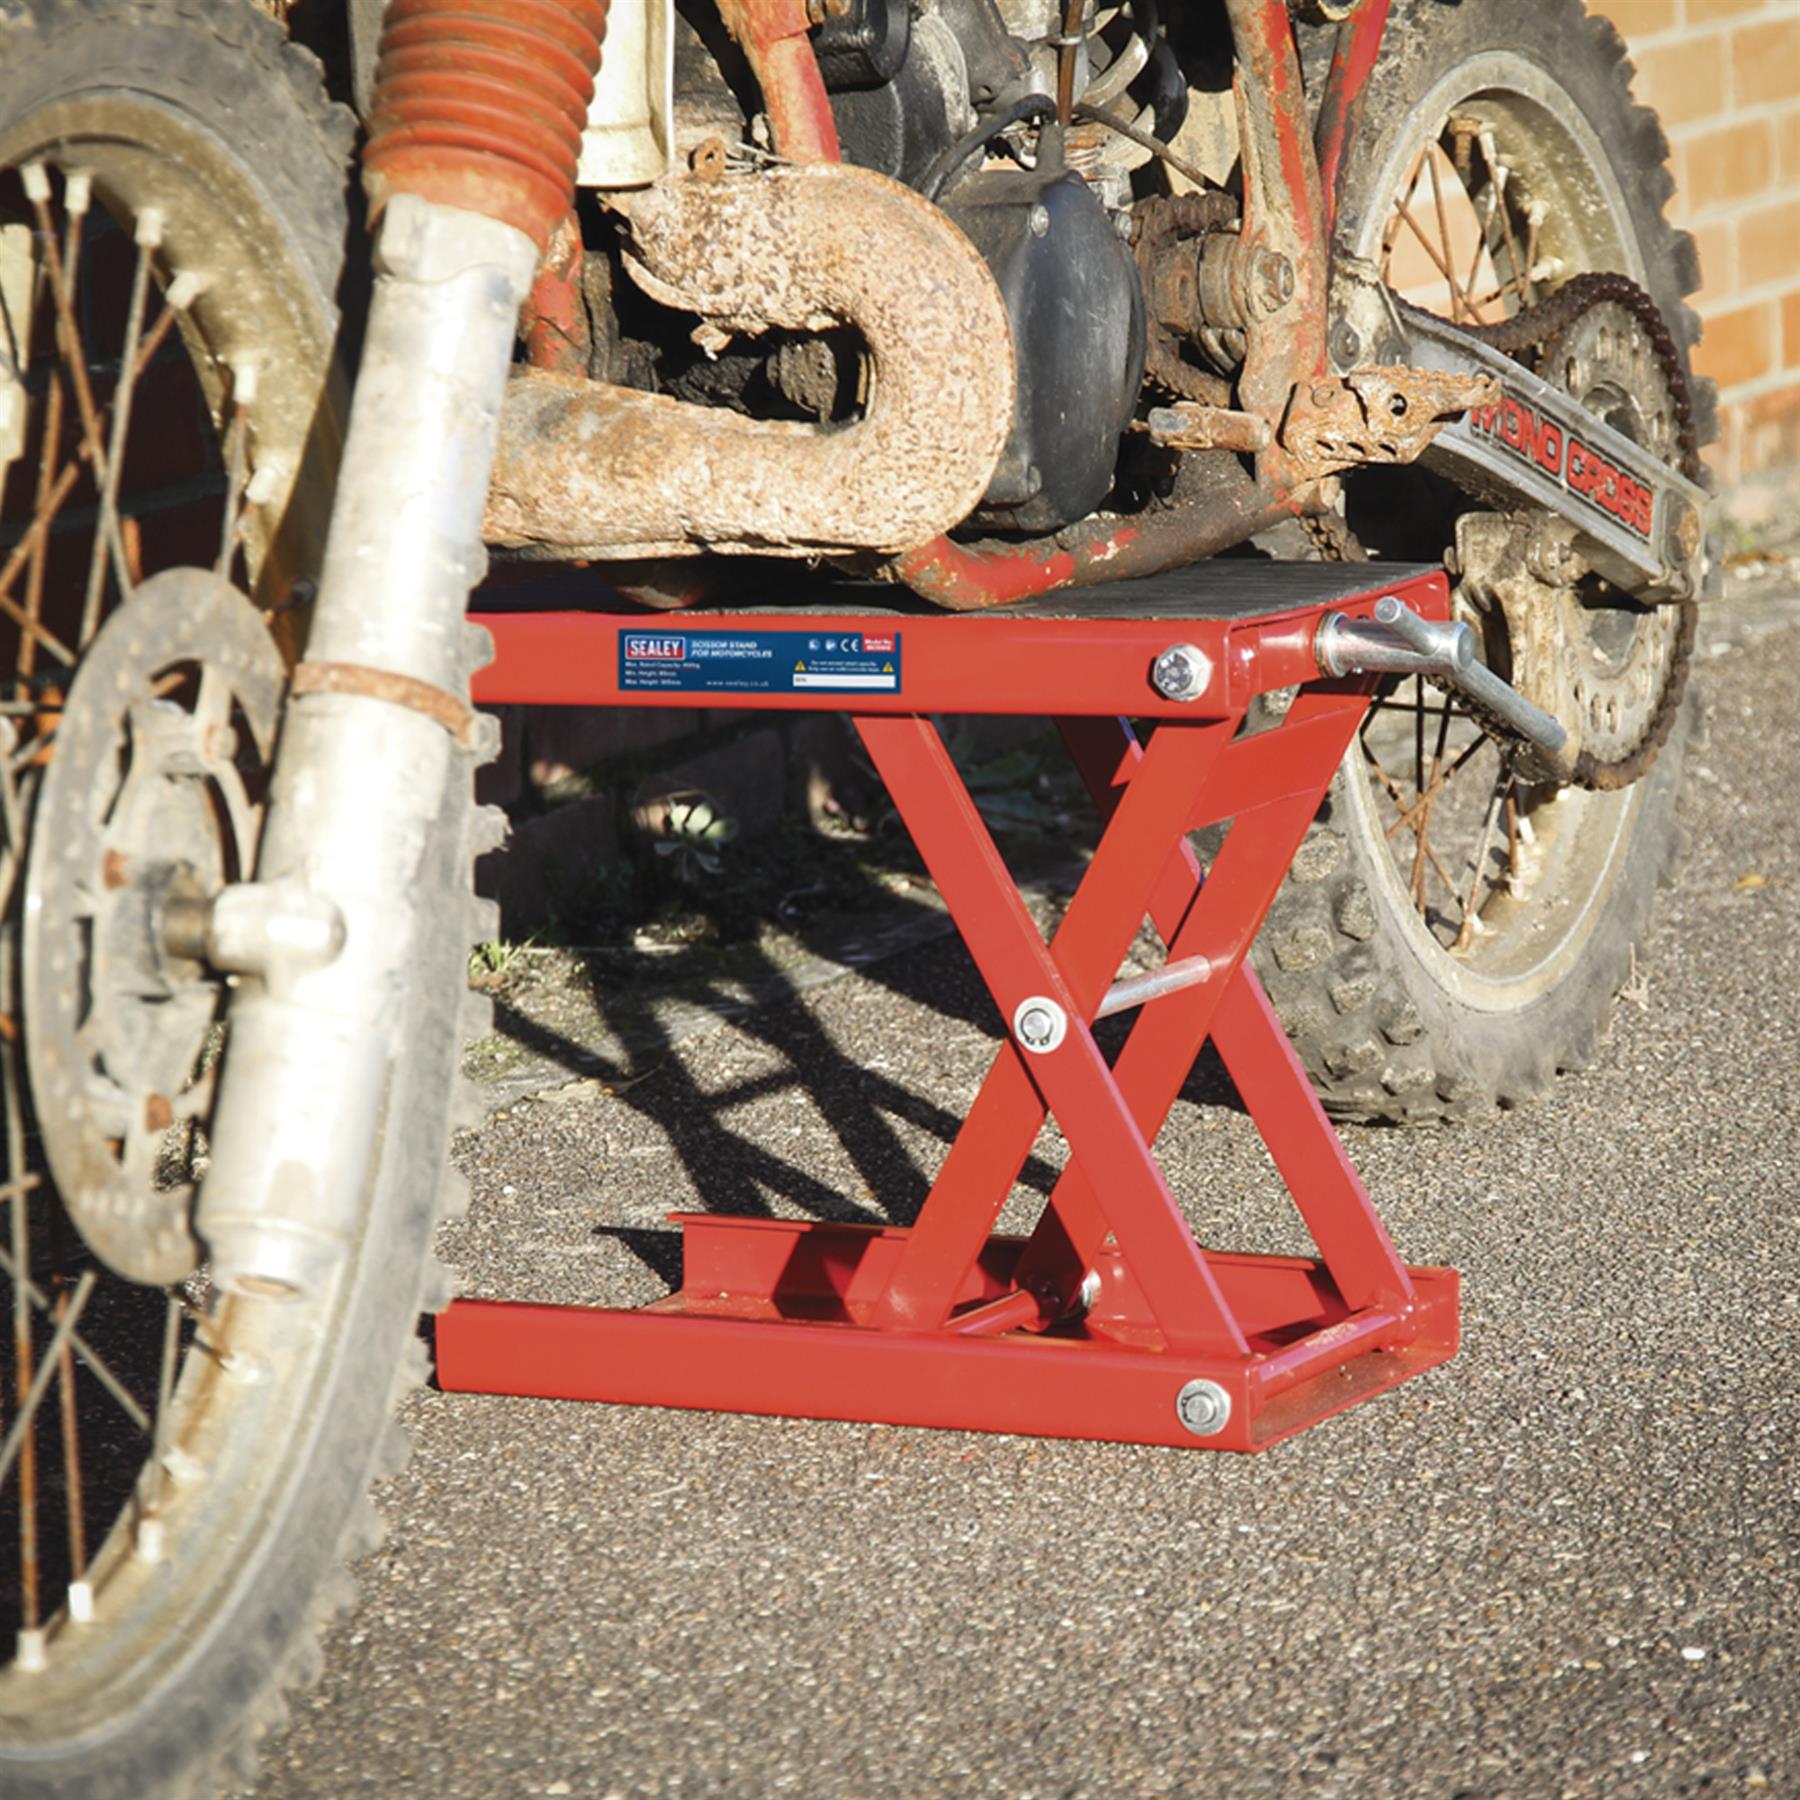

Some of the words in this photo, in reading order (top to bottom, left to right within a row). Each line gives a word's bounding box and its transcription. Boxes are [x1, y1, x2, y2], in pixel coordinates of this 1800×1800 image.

[1471, 396, 1563, 476] MONO
[1566, 437, 1653, 536] CROSS
[630, 640, 680, 657] SEALEY
[691, 641, 728, 649] SCISSOR
[730, 641, 757, 649] STAND
[711, 650, 773, 658] MOTORCYCLES
